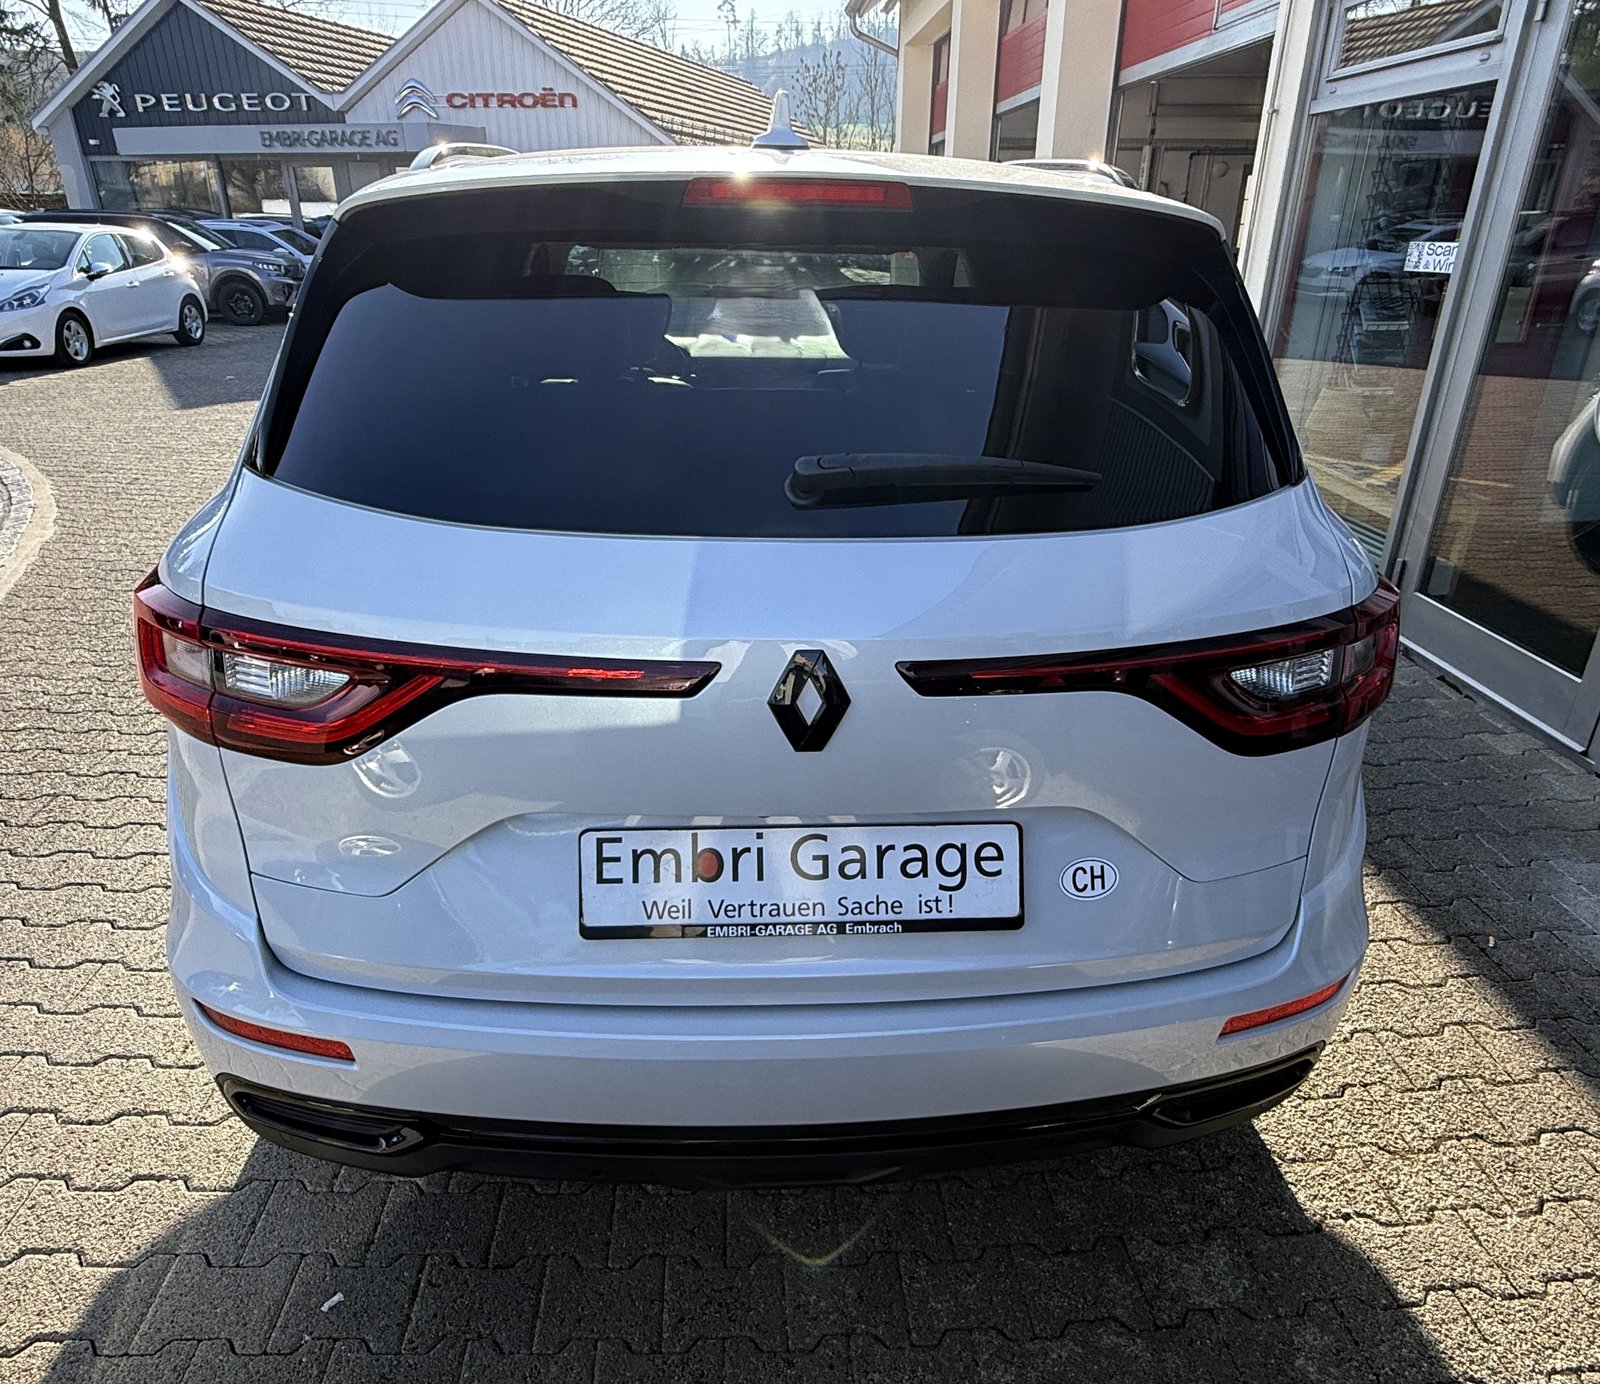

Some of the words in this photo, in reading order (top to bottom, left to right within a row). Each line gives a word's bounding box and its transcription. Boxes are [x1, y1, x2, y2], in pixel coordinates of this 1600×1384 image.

[133, 92, 312, 113] PEUGEOT
[259, 130, 373, 148] EMBRI-GARAGE
[375, 130, 400, 147] AG
[1422, 260, 1432, 270] &
[595, 832, 764, 885] Embri
[789, 833, 1005, 892] Garage
[1071, 864, 1106, 893] CH
[641, 899, 692, 920] Weil
[707, 899, 826, 919] Vertrauen
[837, 894, 904, 916] Sache
[706, 924, 813, 938] EMBRI-GARAGE
[816, 923, 838, 935] AG
[845, 922, 903, 935] Embrach
